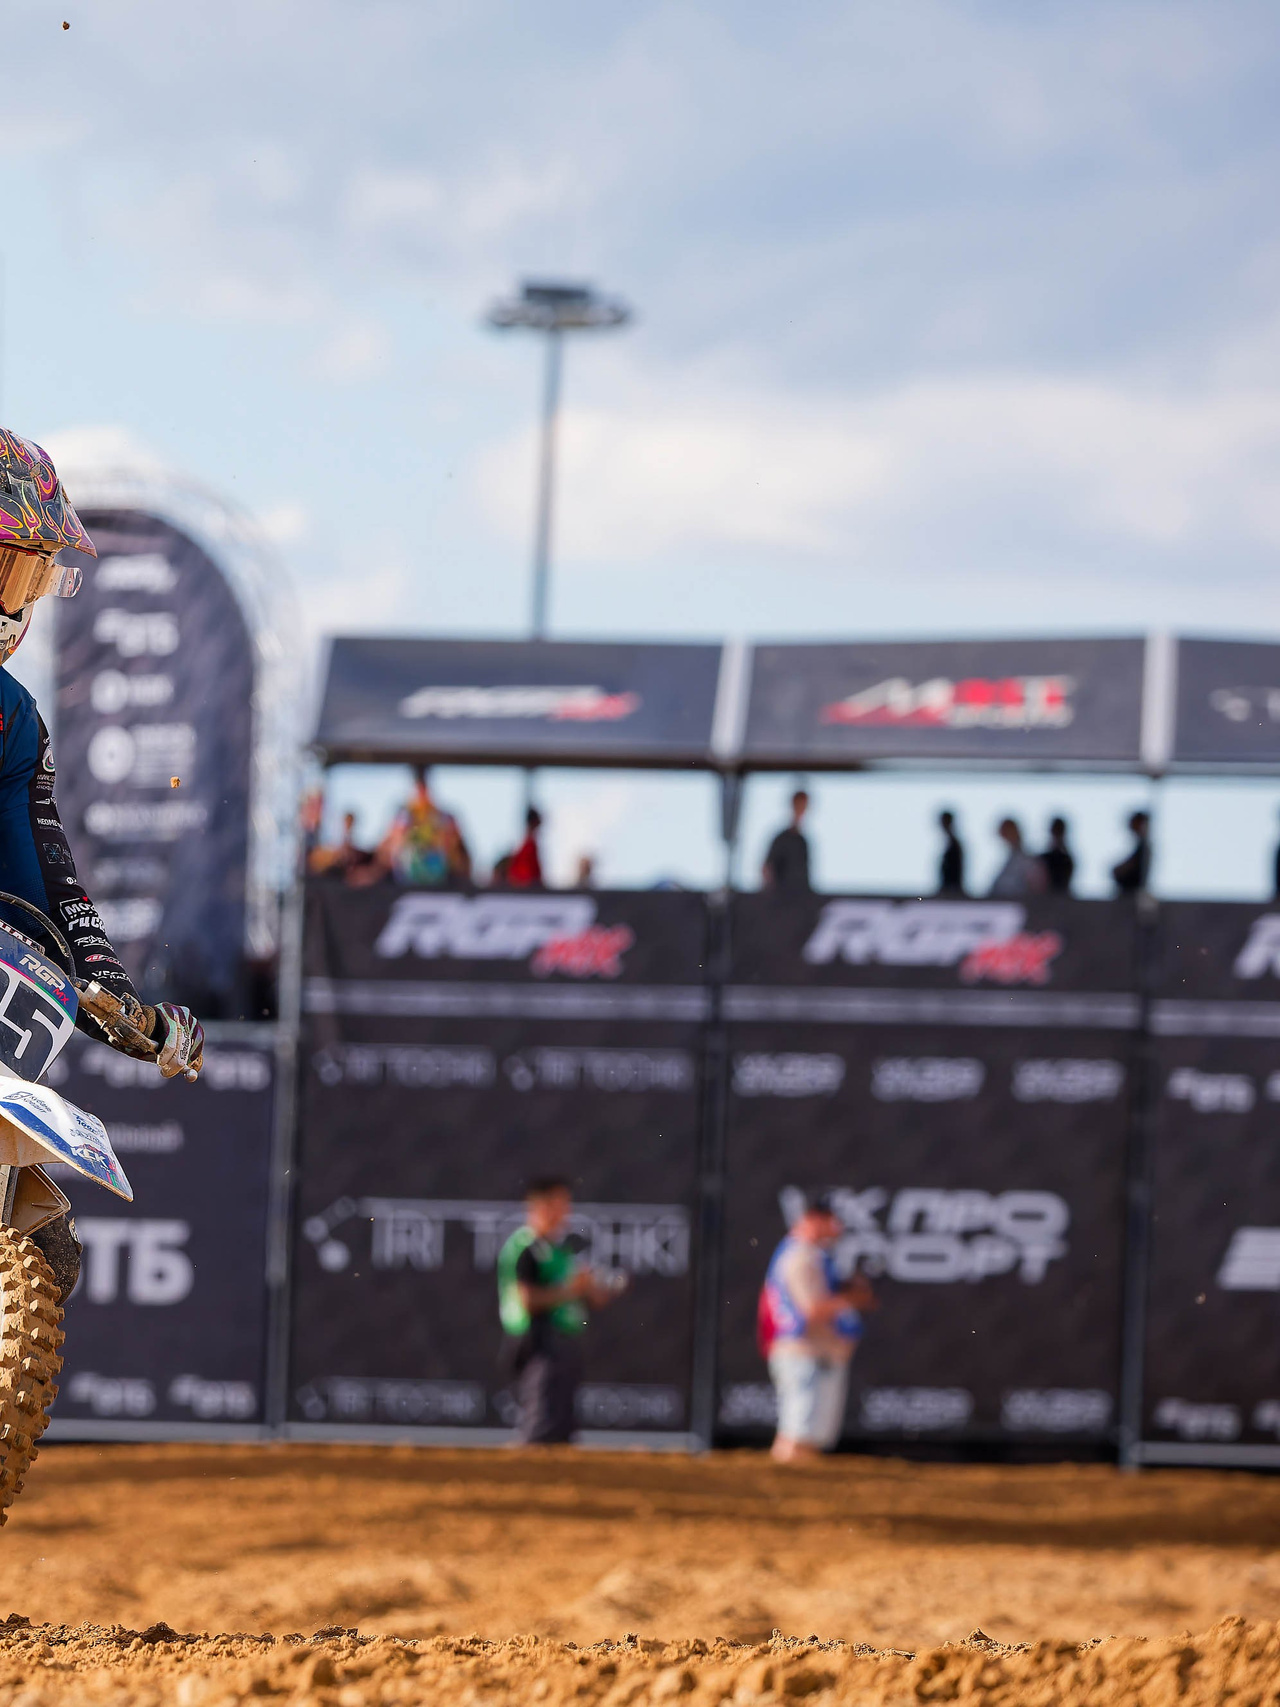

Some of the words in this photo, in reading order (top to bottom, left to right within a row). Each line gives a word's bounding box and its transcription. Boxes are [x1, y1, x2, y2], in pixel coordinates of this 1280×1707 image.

[19, 953, 66, 992] RGP
[53, 987, 70, 1006] MX
[74, 1218, 195, 1303] ТБ
